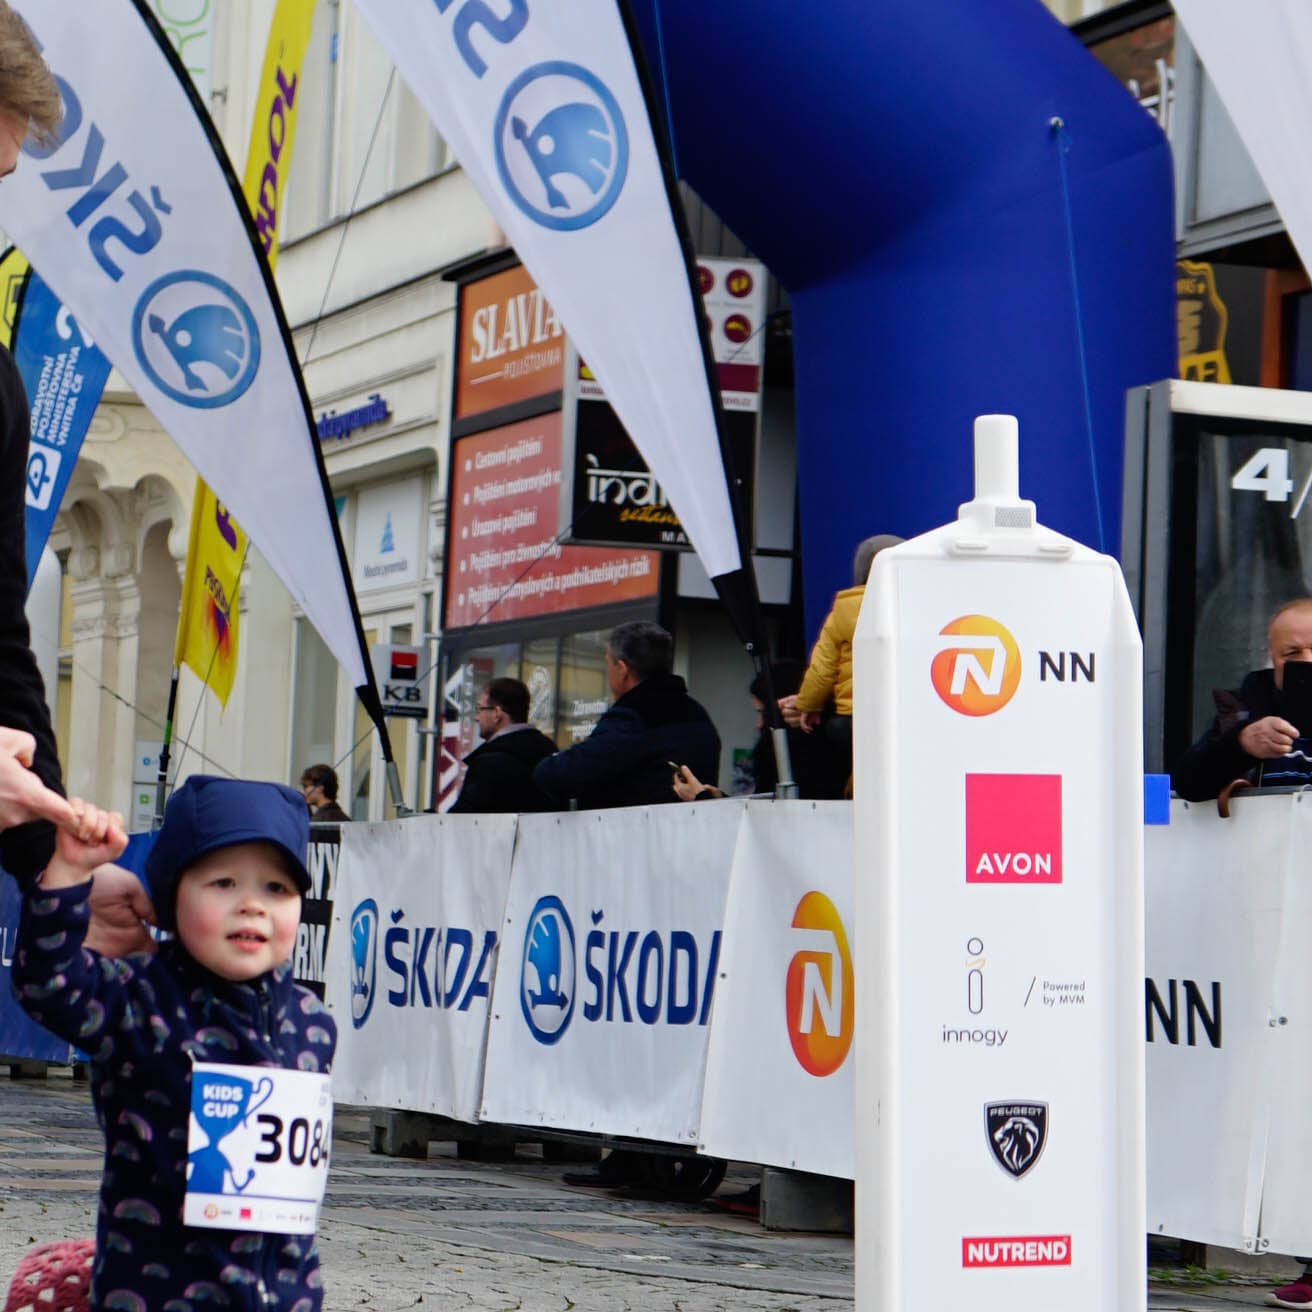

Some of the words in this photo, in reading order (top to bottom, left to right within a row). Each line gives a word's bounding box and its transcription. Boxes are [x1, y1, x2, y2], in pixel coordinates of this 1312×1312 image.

[1038, 650, 1095, 682] NN
[383, 684, 421, 702] KB
[975, 852, 1052, 875] AVON
[1043, 981, 1086, 992] Powered
[1043, 995, 1055, 1007] by
[1059, 995, 1085, 1004] MVM
[942, 1024, 1009, 1046] innogy
[202, 1084, 244, 1101] KIDS
[202, 1102, 240, 1119] CUP
[990, 1106, 1043, 1117] PEUGEOT
[967, 1242, 1067, 1264] NUTREND
